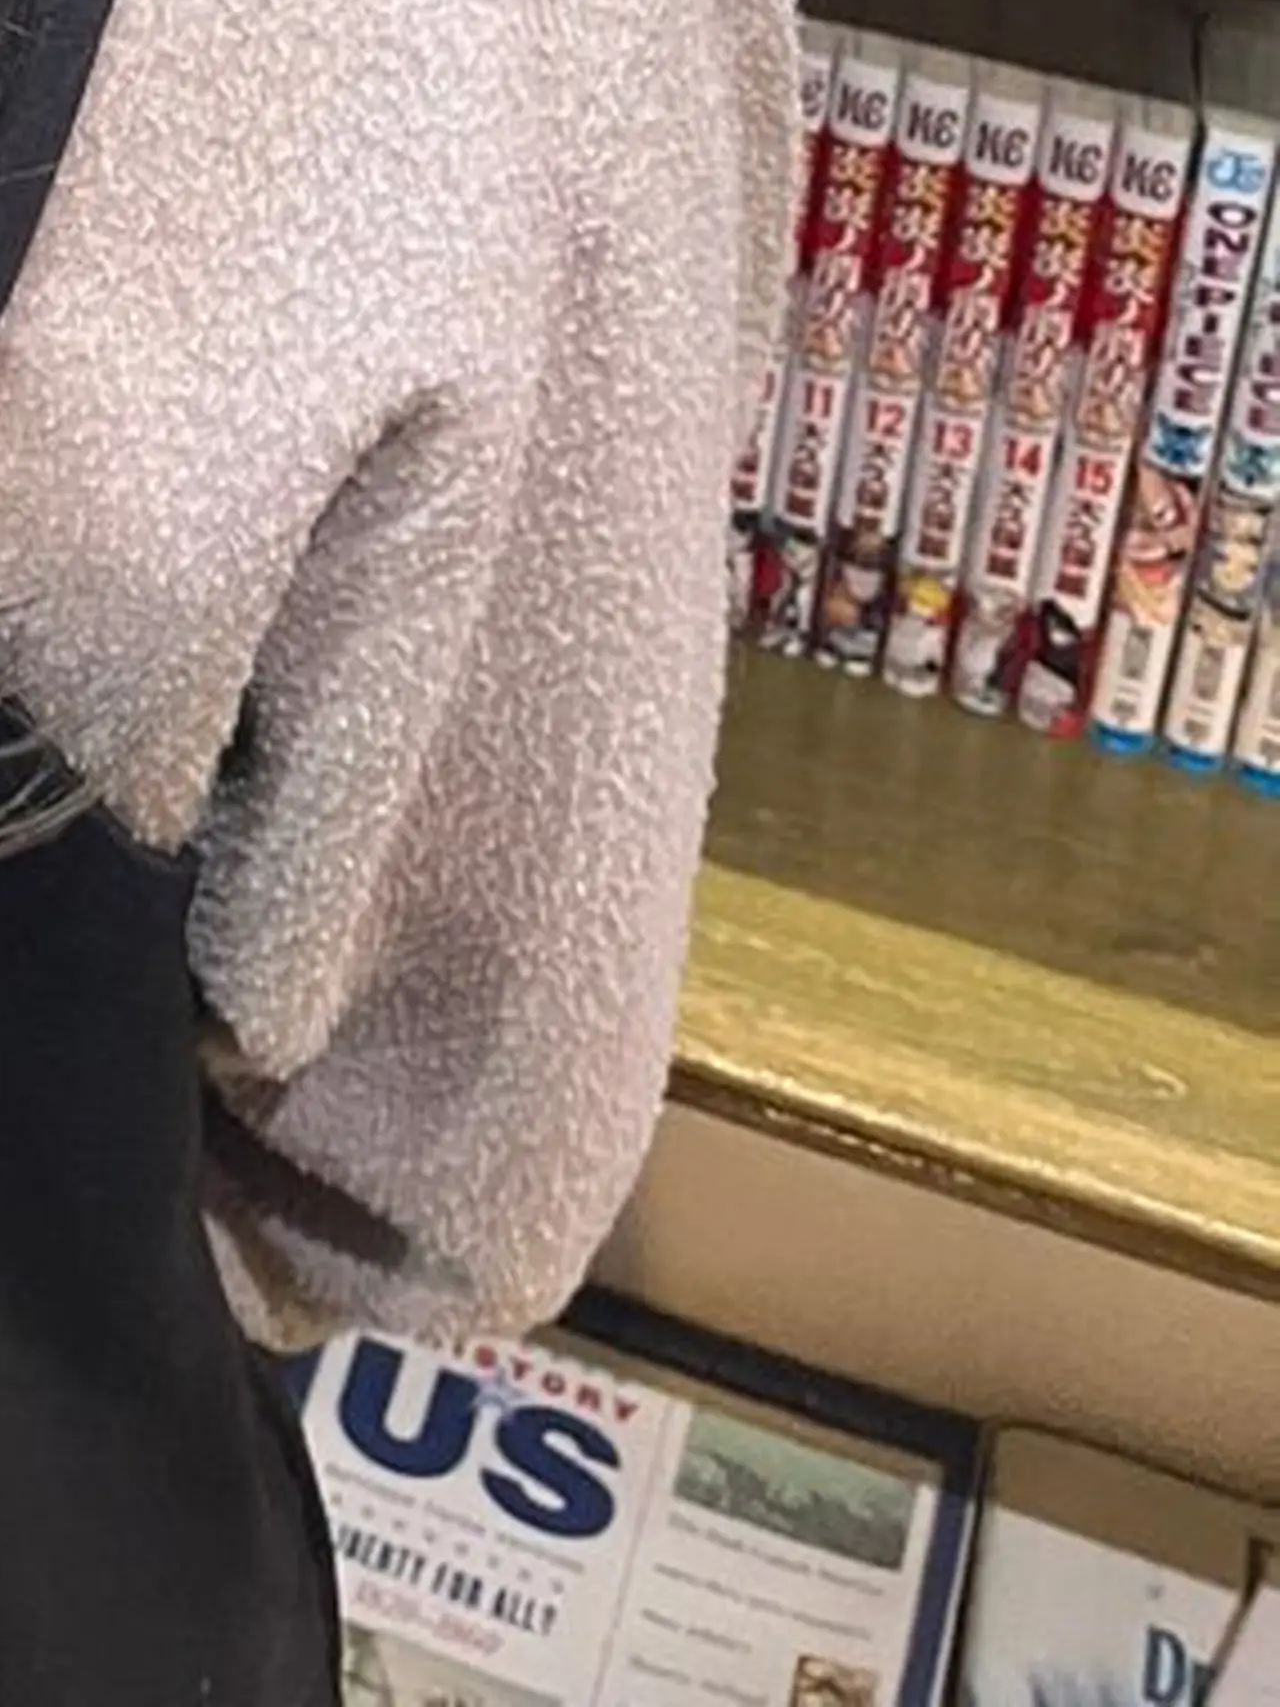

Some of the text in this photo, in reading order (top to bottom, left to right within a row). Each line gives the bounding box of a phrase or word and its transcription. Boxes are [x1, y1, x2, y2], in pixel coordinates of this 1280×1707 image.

[1204, 201, 1257, 279] ONE
[1172, 284, 1237, 415] PIECE
[803, 379, 834, 419] 11
[867, 398, 907, 440] 12
[933, 419, 974, 461] 13
[1004, 437, 1043, 477] 14
[1075, 455, 1119, 496] 15
[338, 1335, 622, 1540] US
[430, 1562, 484, 1610] FOR
